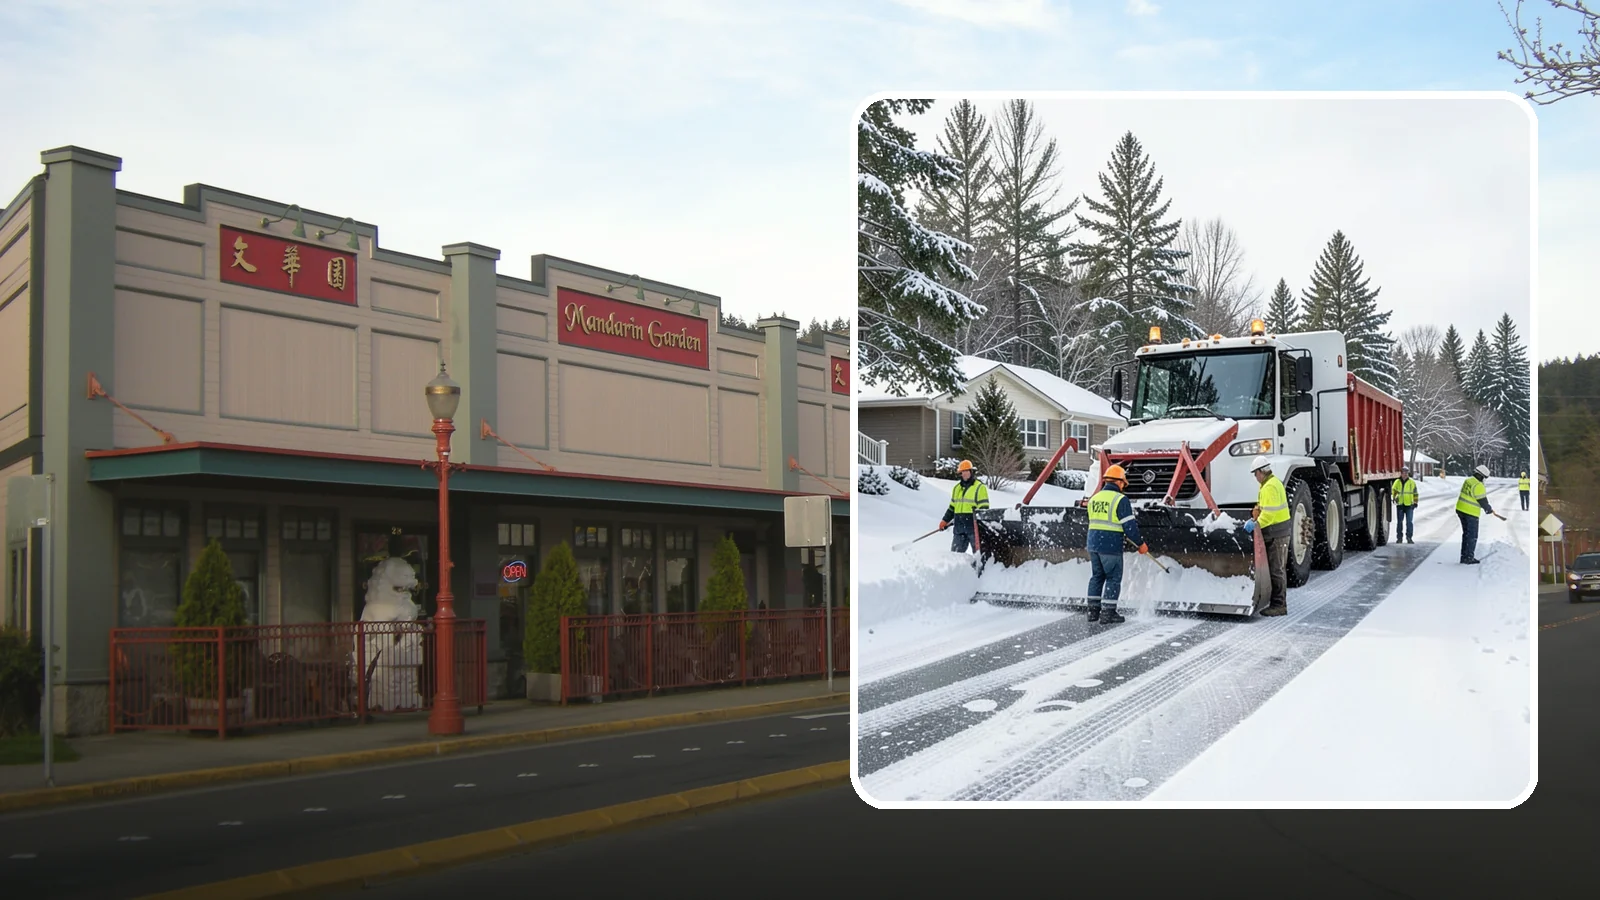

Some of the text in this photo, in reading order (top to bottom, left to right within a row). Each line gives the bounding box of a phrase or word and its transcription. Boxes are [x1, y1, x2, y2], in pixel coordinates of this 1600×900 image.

[230, 235, 347, 291] 文華園
[564, 302, 702, 352] Mandarin Garden
[503, 565, 527, 578] OPEN
